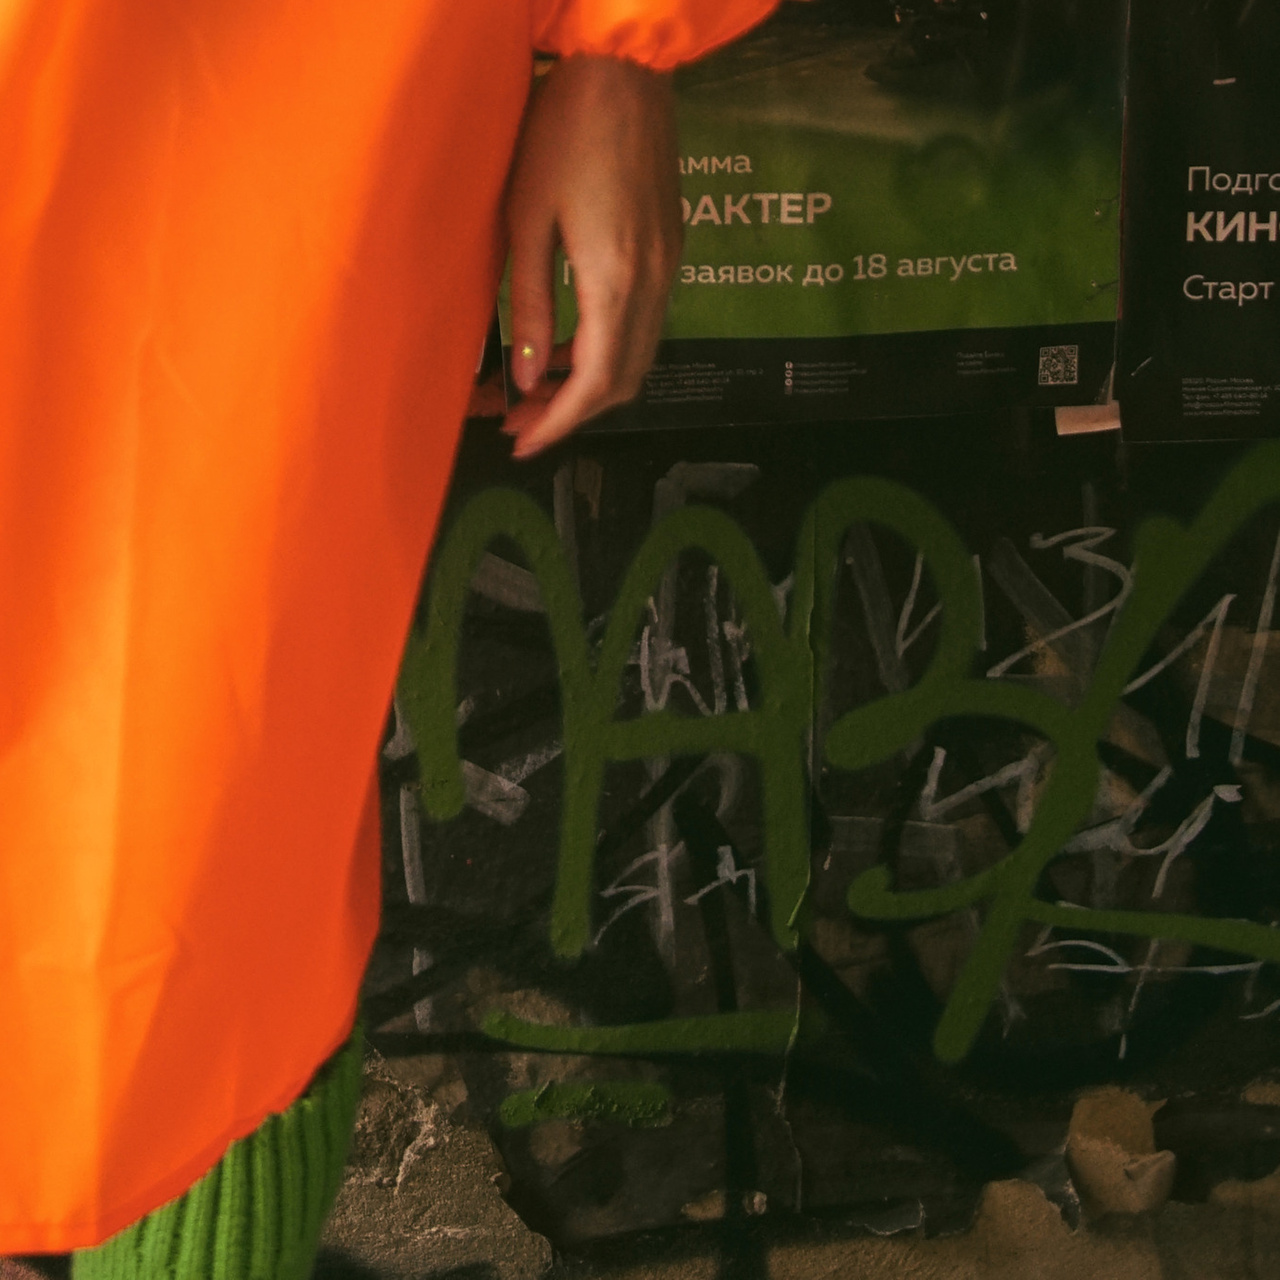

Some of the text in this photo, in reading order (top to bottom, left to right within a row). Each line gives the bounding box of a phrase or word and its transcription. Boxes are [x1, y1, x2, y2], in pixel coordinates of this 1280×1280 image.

[680, 251, 1018, 288] заявок до 18 августа
[1182, 273, 1275, 307] Старт
